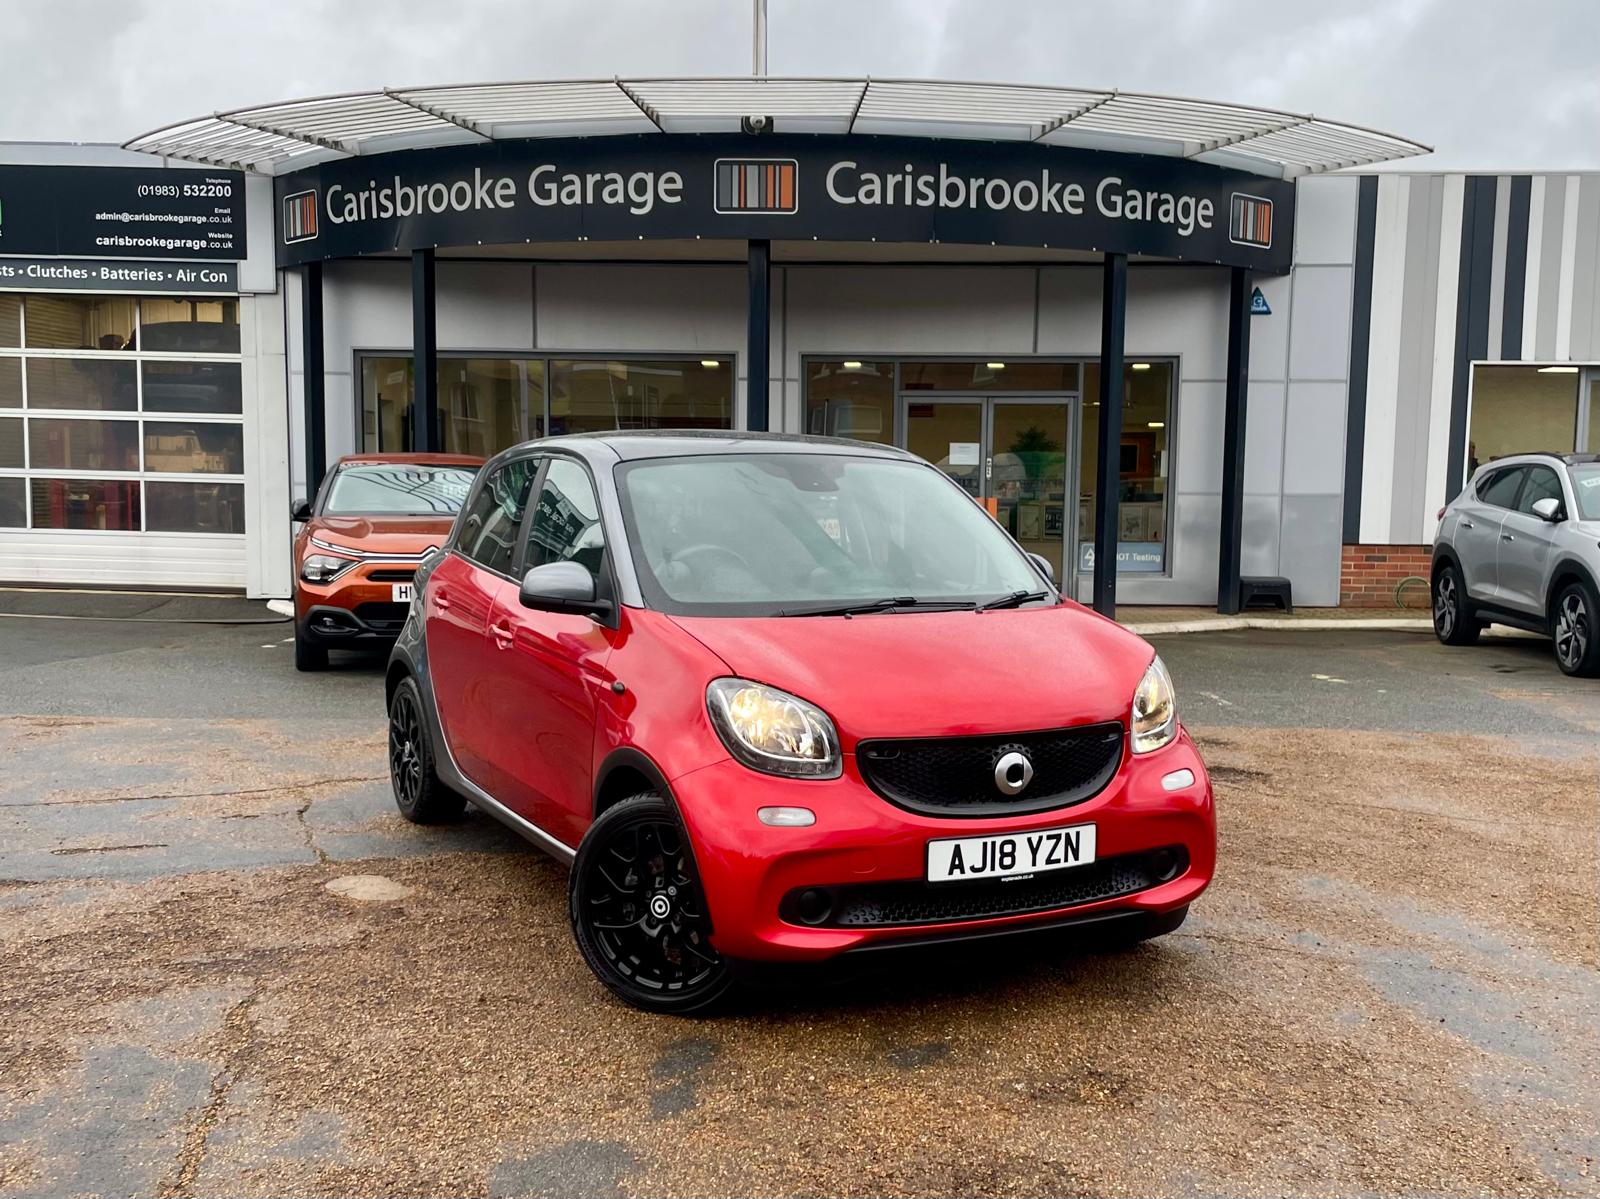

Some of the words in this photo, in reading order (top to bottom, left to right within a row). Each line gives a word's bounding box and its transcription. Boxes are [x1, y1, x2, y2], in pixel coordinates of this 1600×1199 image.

[137, 185, 180, 198] (01983)
[183, 184, 232, 198] 532200
[325, 167, 517, 224] Carisbrooke
[528, 164, 684, 216] Garage
[825, 160, 1085, 215] Carisbrooke
[1096, 176, 1214, 237] Garage
[95, 212, 233, 224] admin@carisbrookegarage.co.uk
[96, 235, 233, 250] carisbrookegarage.co.uk
[0, 265, 15, 277] ts
[27, 264, 89, 279] Clutches
[100, 267, 164, 282] Batteries
[176, 269, 197, 283] Air
[200, 269, 228, 283] Con
[1132, 552, 1161, 563] Testing
[399, 585, 411, 599] H
[948, 839, 1016, 875] AJ18
[1027, 830, 1081, 868] YZN
